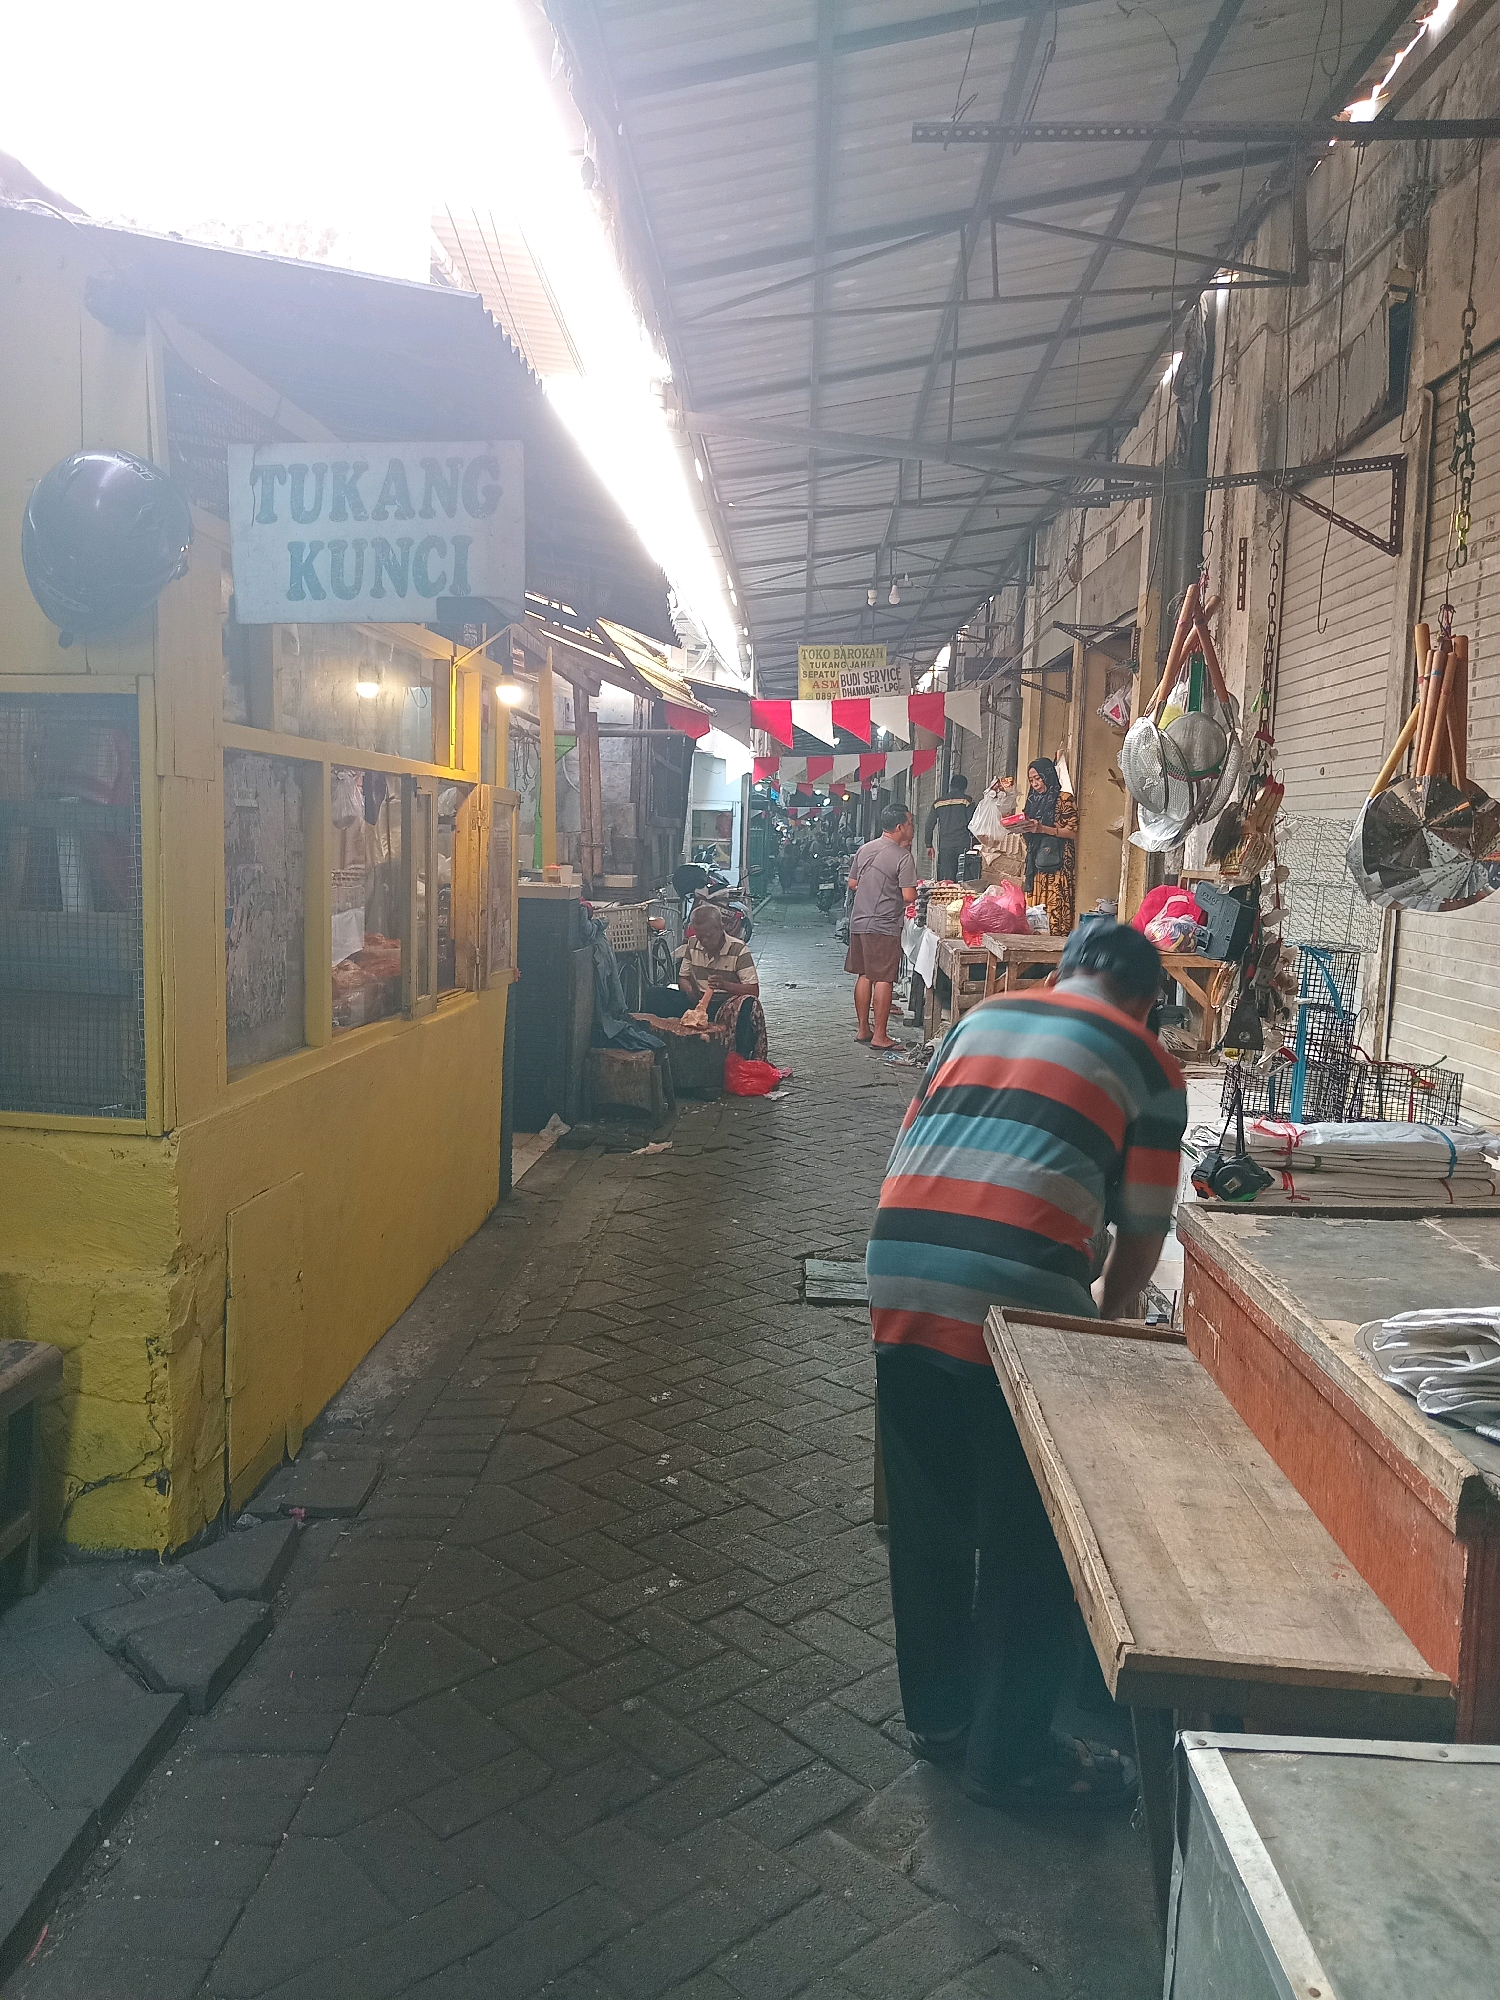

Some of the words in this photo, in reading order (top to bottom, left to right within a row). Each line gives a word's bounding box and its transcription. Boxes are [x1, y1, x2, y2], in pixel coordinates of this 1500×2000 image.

[249, 455, 504, 525] TUKANG
[285, 534, 474, 601] KUNCI
[801, 648, 831, 660] TOKO
[833, 647, 884, 660] BAROKAH
[809, 661, 847, 669] TUKANG
[849, 660, 876, 668] JAHIT
[802, 670, 836, 679] SEPATU
[840, 672, 860, 688] BUDI
[862, 667, 902, 684] SERVICE
